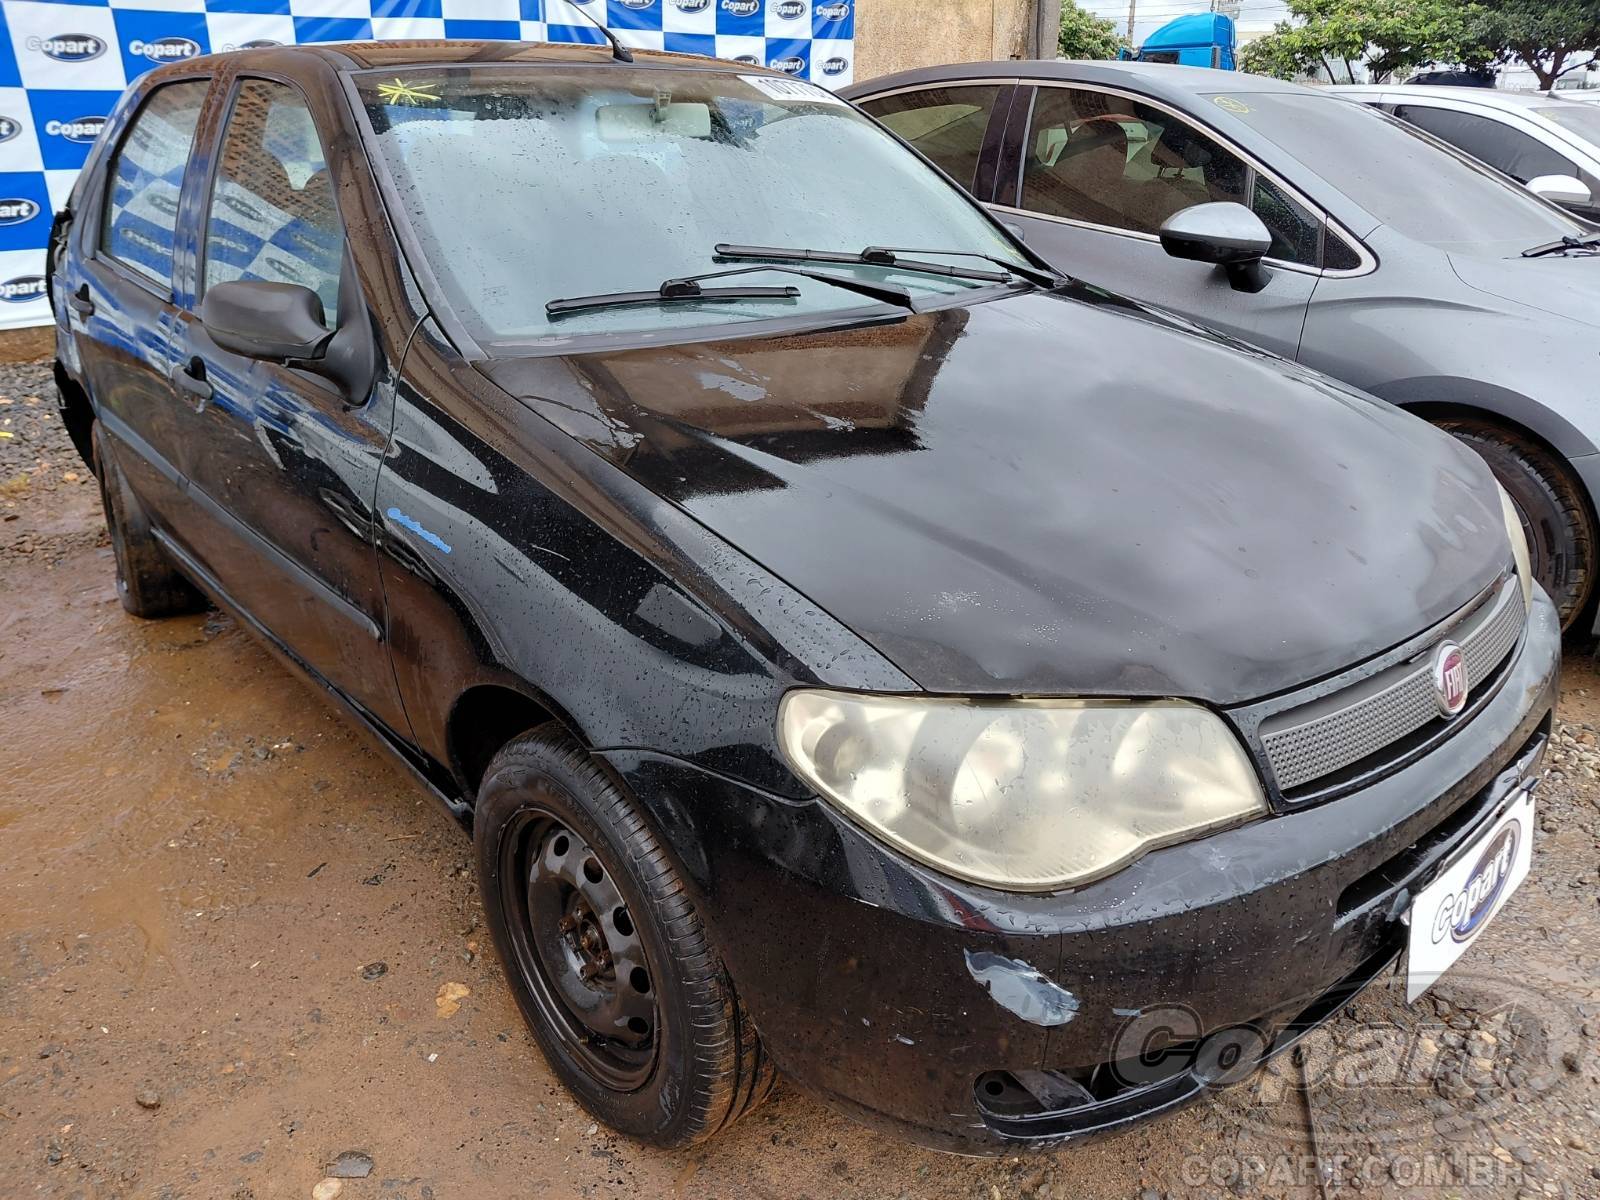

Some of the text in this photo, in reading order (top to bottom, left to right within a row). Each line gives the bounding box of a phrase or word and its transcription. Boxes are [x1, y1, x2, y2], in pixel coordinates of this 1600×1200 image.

[770, 3, 802, 15] Copart
[816, 6, 846, 16] Copart
[25, 36, 97, 57] Copart
[129, 40, 193, 57] Copart
[815, 60, 844, 70] Copart
[45, 119, 104, 138] Copar
[1432, 829, 1513, 945] Copart
